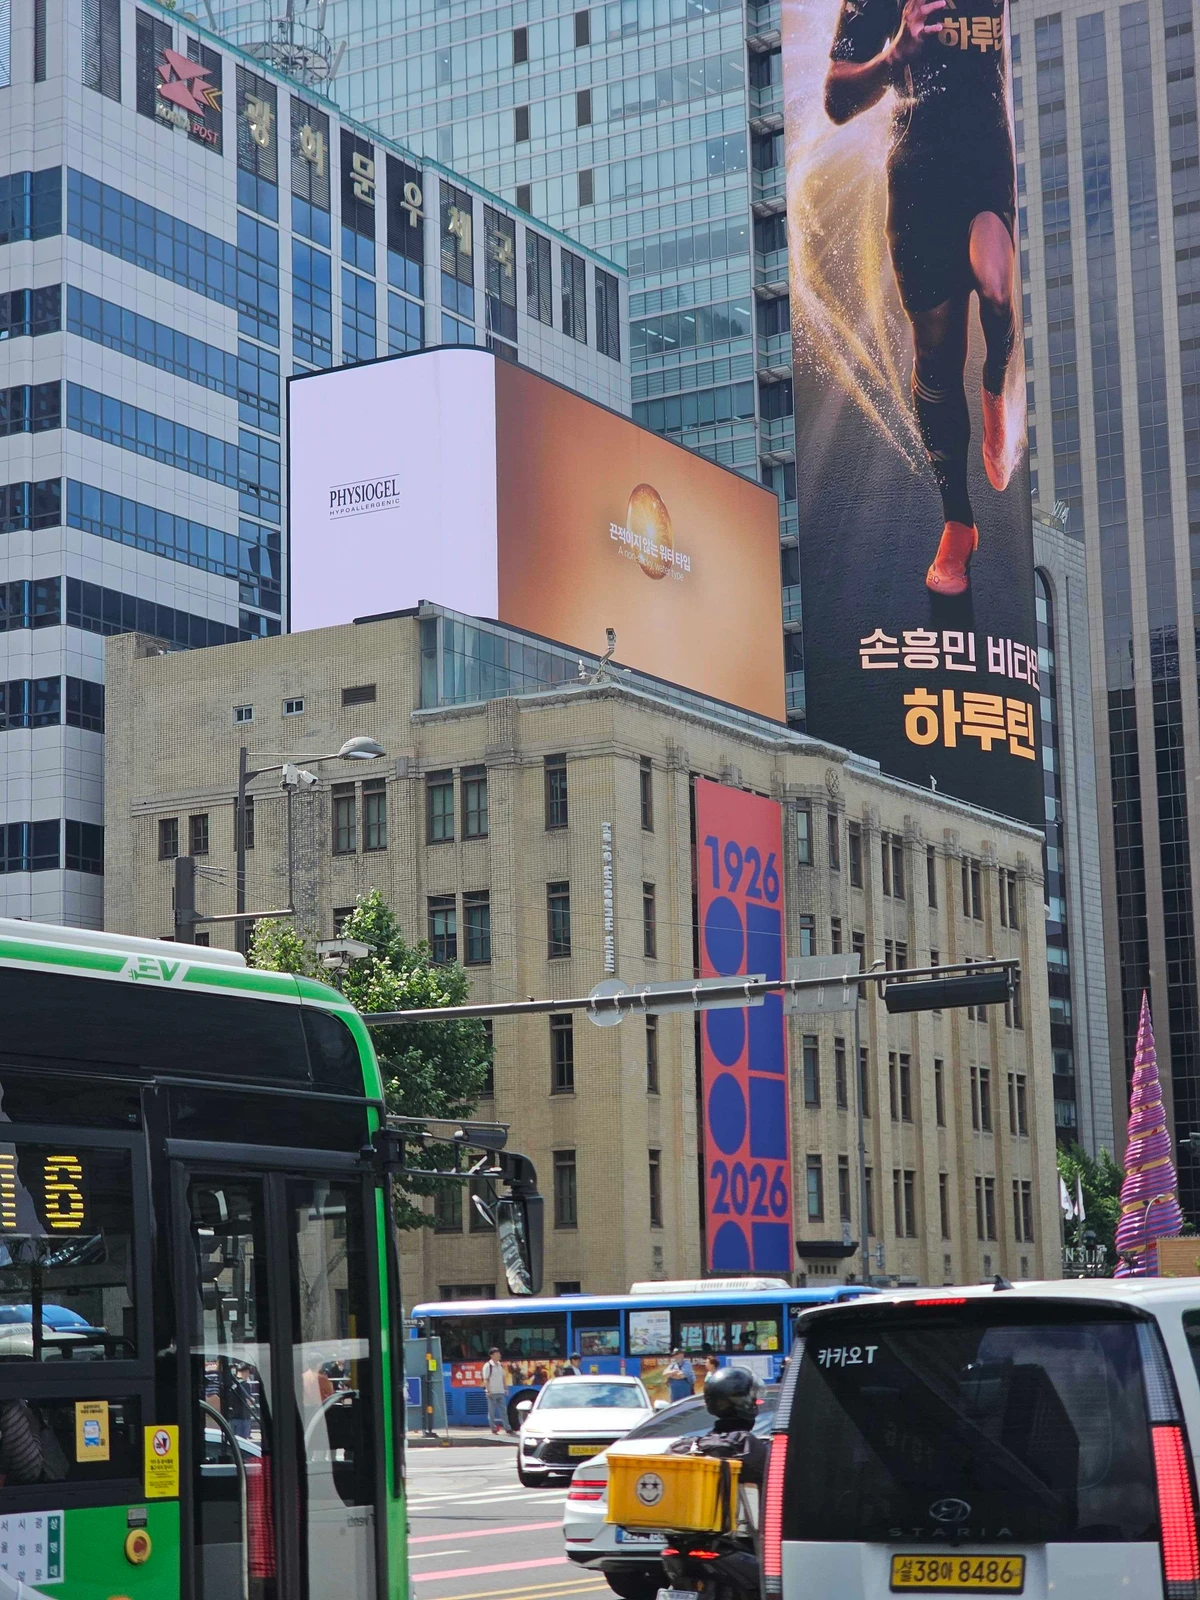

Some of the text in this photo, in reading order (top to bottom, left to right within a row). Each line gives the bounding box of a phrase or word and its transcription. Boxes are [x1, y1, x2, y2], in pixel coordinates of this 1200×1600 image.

[155, 103, 219, 145] KOREA POST
[329, 479, 400, 508] PHYSIOGEL
[329, 498, 400, 516] HYPOALLERGENIC
[659, 544, 675, 566] 워터
[675, 552, 691, 572] 타입
[859, 627, 977, 672] 손흥민
[903, 687, 1036, 761] 하루틴
[704, 834, 780, 904] 1926
[132, 956, 181, 981] EV
[711, 1159, 788, 1218] 2026
[49, 1517, 59, 1578] 상명대
[888, 1527, 1013, 1538] STARIA
[957, 1560, 1014, 1583] 8486
